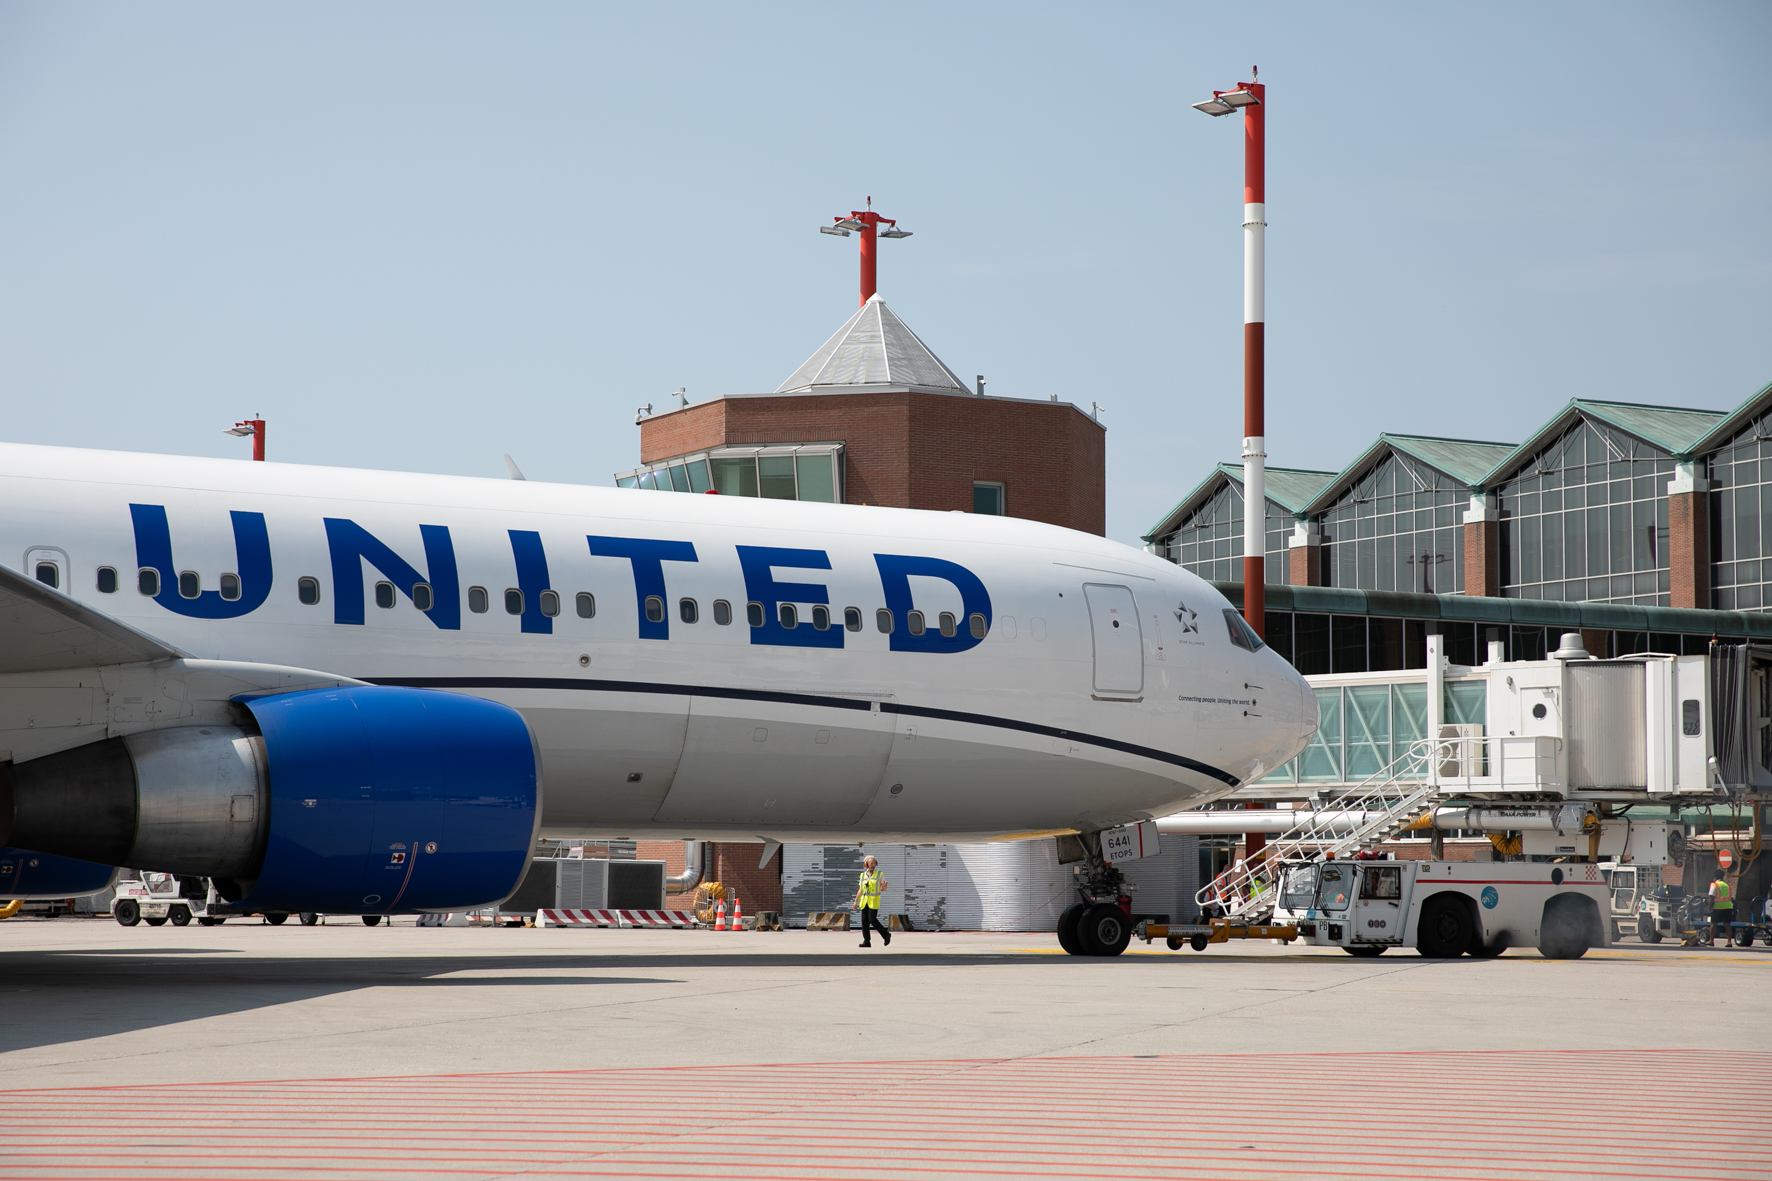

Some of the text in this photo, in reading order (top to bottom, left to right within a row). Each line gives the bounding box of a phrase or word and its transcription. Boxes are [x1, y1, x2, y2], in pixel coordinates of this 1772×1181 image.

[128, 503, 992, 654] UNITED
[1178, 695, 1201, 703] Connecting
[1217, 697, 1231, 705] Uniting
[1108, 835, 1131, 848] 6441
[1110, 849, 1133, 860] ETOPS
